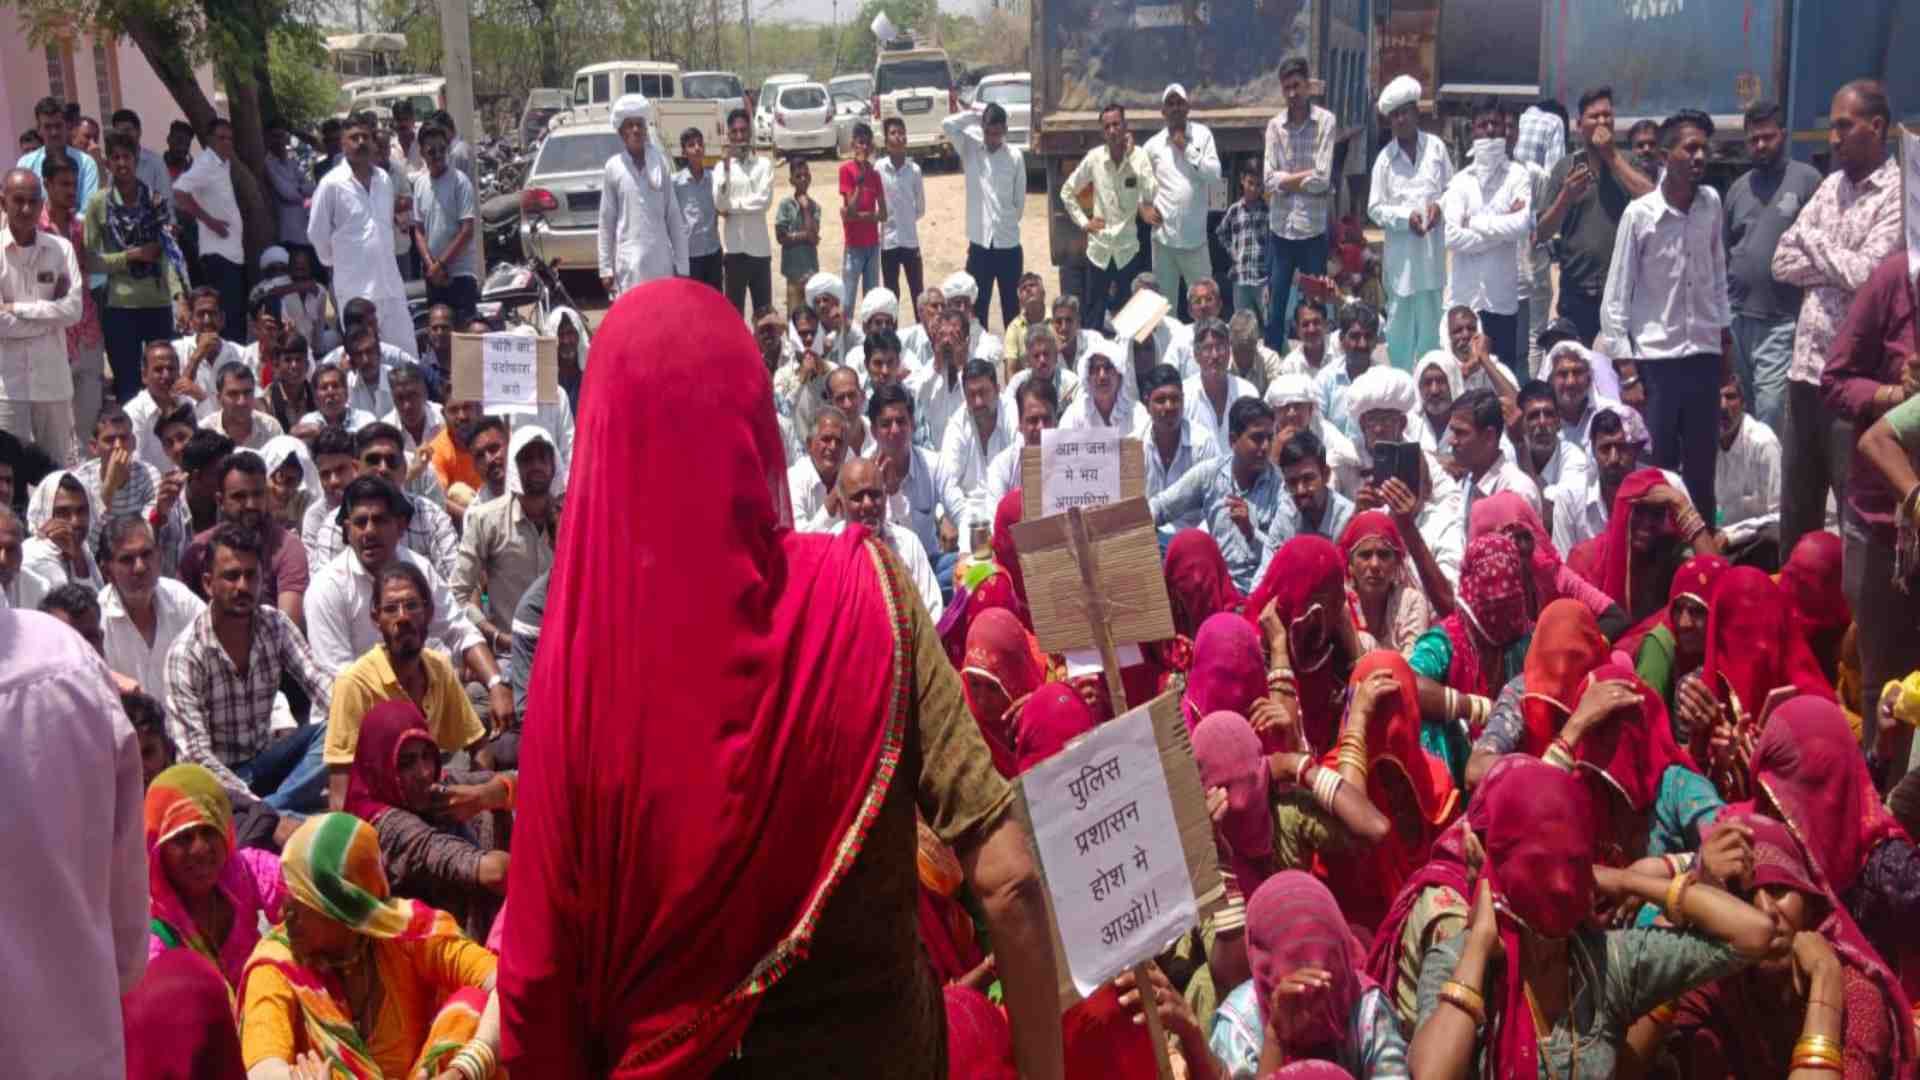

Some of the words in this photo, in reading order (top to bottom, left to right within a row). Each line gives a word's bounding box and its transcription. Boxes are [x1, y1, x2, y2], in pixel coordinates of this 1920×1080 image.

[1056, 441, 1079, 456] आम
[1086, 441, 1106, 455] जन
[1080, 468, 1099, 481] भय
[1067, 755, 1122, 811] पुलिस
[1073, 800, 1141, 856] प्रशासन
[1089, 863, 1127, 902] होश
[1133, 845, 1149, 873] मे
[1101, 888, 1161, 946] आओ!!
